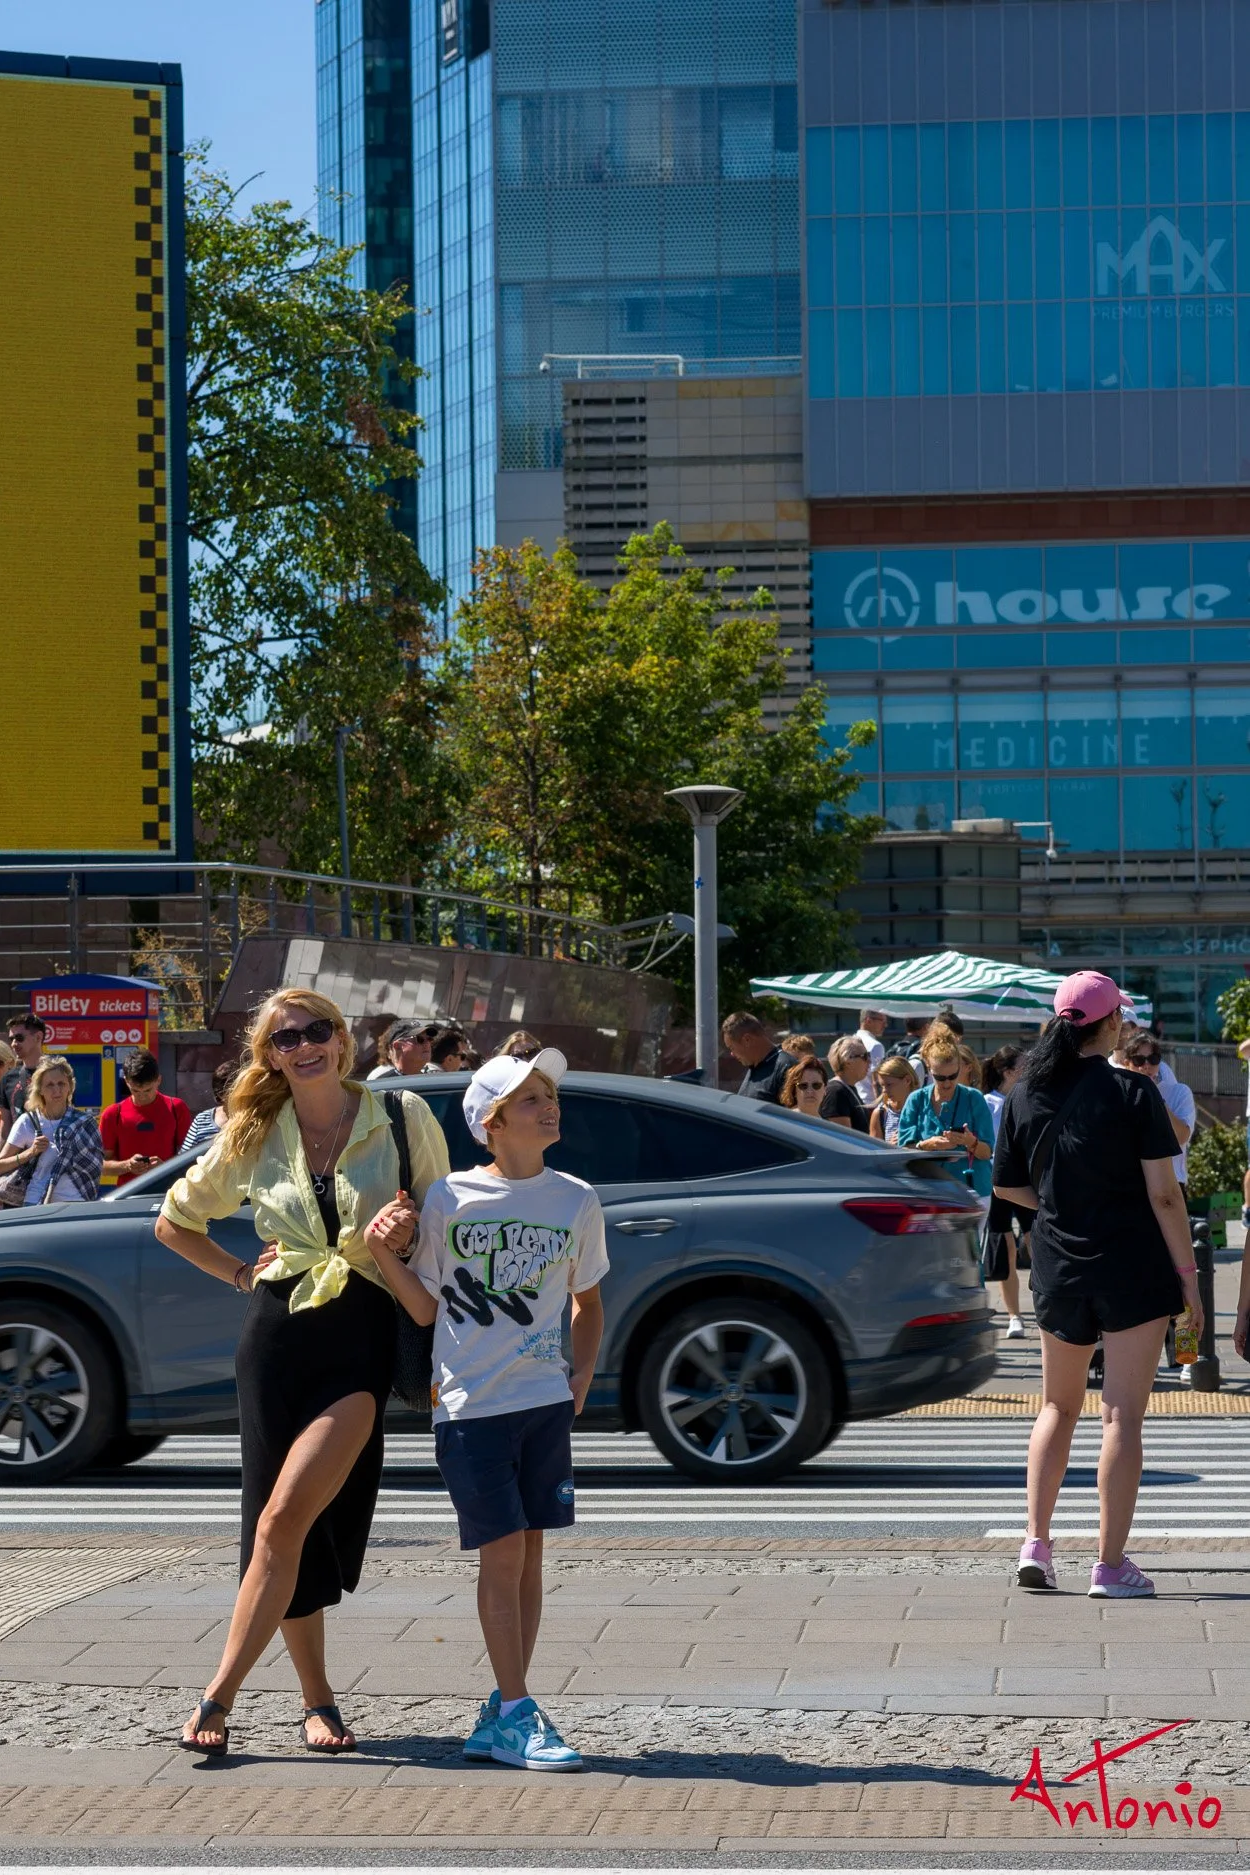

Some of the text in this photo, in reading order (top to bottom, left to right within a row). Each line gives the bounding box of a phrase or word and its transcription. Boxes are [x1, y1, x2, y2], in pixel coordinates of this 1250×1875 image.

[1097, 215, 1226, 295] MAX
[1093, 302, 1234, 321] PREMIUM BURGERS
[935, 581, 1231, 624] house
[934, 734, 1150, 768] MEDICINE
[35, 995, 90, 1015] Bilety
[99, 999, 142, 1012] tickets
[454, 1221, 572, 1263] GET READY
